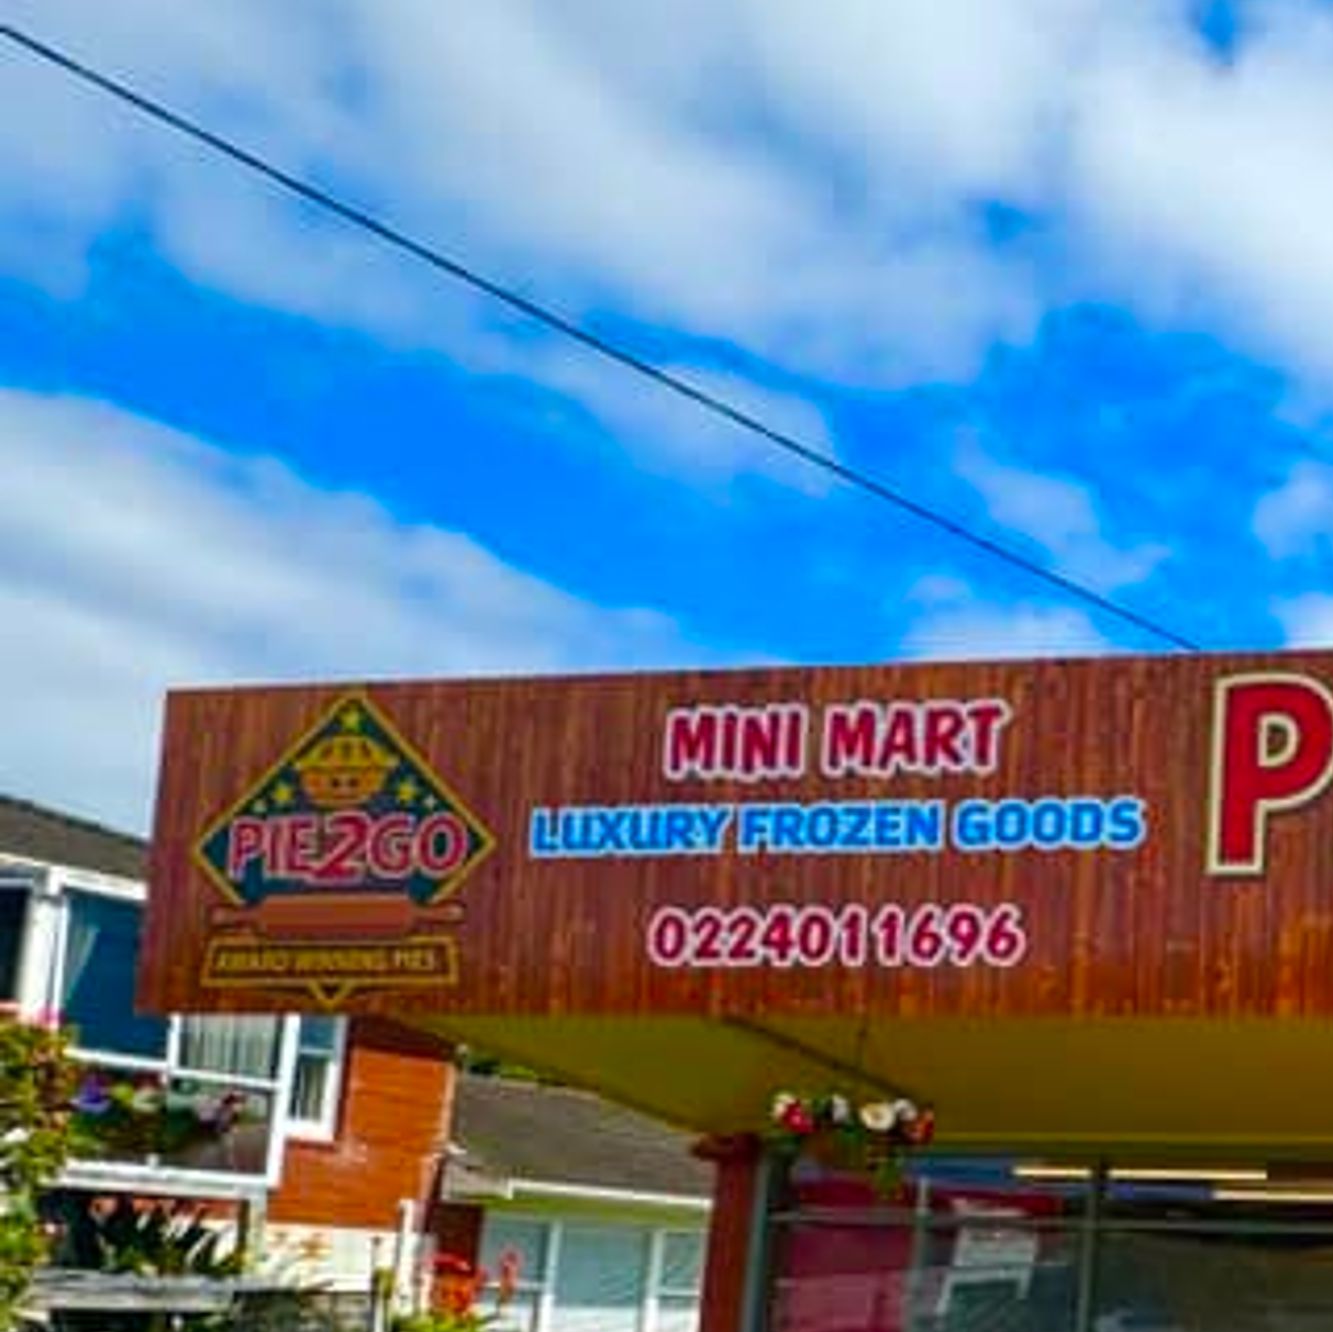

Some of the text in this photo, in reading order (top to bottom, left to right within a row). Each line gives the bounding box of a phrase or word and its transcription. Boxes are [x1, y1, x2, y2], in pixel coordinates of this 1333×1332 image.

[663, 699, 1008, 782] MINI MART
[227, 810, 468, 886] PIE2GO
[528, 797, 1146, 859] LUXURY FROZEN GOODS
[648, 904, 1026, 968] 0224011696
